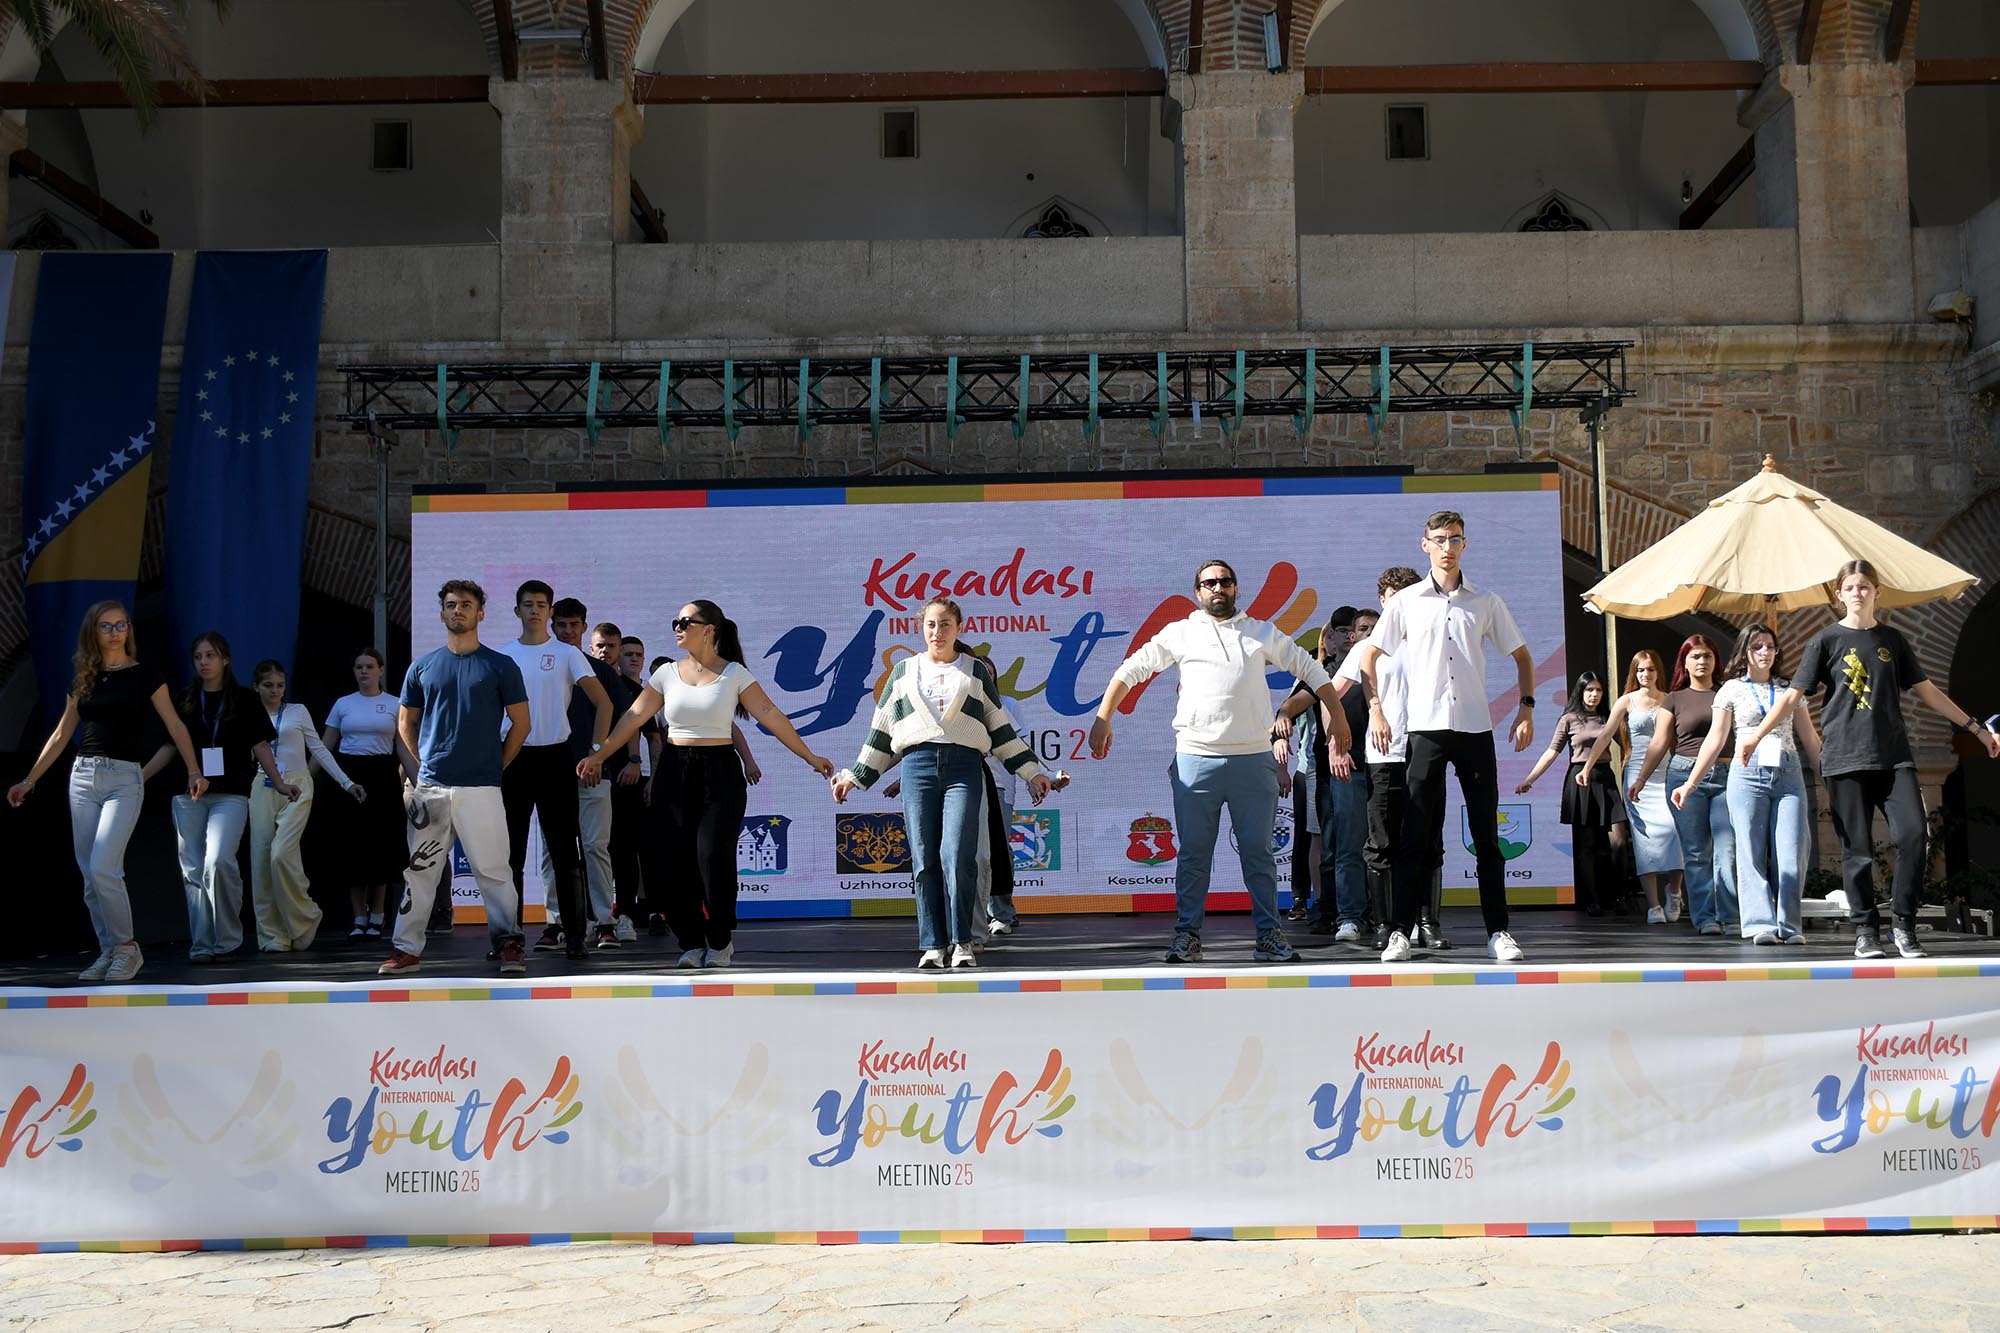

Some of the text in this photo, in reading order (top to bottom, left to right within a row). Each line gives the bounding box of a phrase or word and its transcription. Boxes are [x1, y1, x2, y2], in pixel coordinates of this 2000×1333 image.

[889, 615, 1051, 634] INTATIONAL
[1465, 870, 1532, 880] Lreg
[1870, 1068, 1950, 1082] INTERNATIONAL
[870, 1084, 946, 1096] INTERNATIONAL
[1367, 1077, 1444, 1090] INTERNATIONAL
[381, 1091, 456, 1104] INTERNATIONAL
[1883, 1147, 1981, 1171] MEETING 25
[878, 1163, 973, 1186] MEETING 25
[1377, 1157, 1474, 1180] MEETING 25
[386, 1170, 480, 1193] MEETING 25
